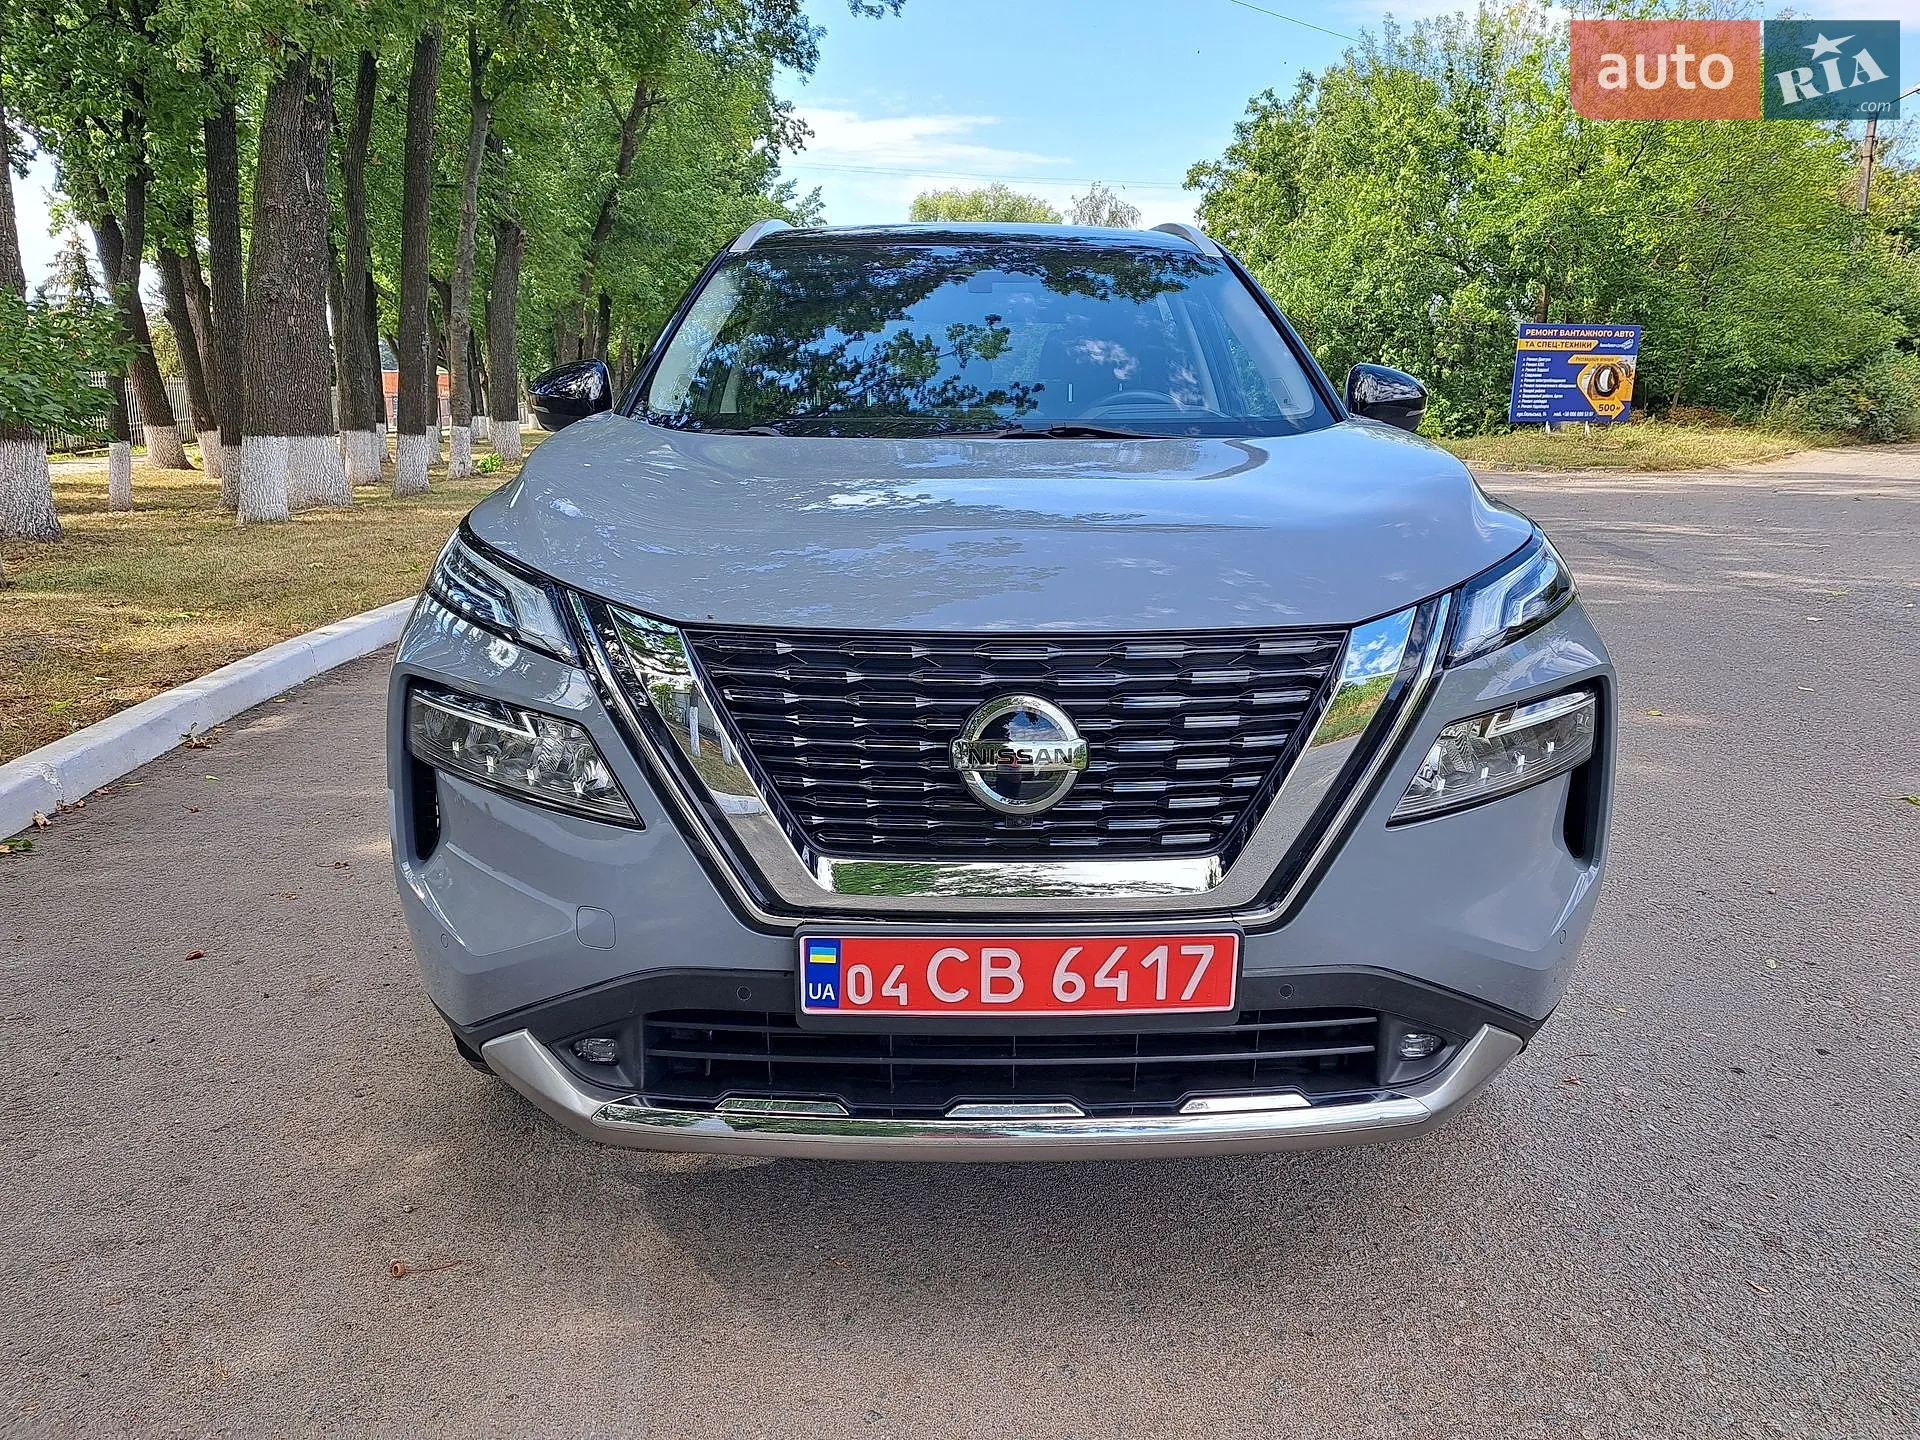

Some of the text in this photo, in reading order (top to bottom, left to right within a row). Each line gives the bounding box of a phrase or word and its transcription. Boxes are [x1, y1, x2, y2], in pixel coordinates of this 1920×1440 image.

[1525, 328, 1635, 338] РЕМОНТ ВАНТАЖНОГО АВТО
[1525, 340, 1535, 348] ТА
[1537, 340, 1592, 349] СПЕЦ-ТЕХНІКИ
[968, 748, 1073, 765] NISSAN
[846, 964, 909, 1006] 04
[1051, 944, 1216, 1004] 6417
[808, 982, 836, 1001] UA
